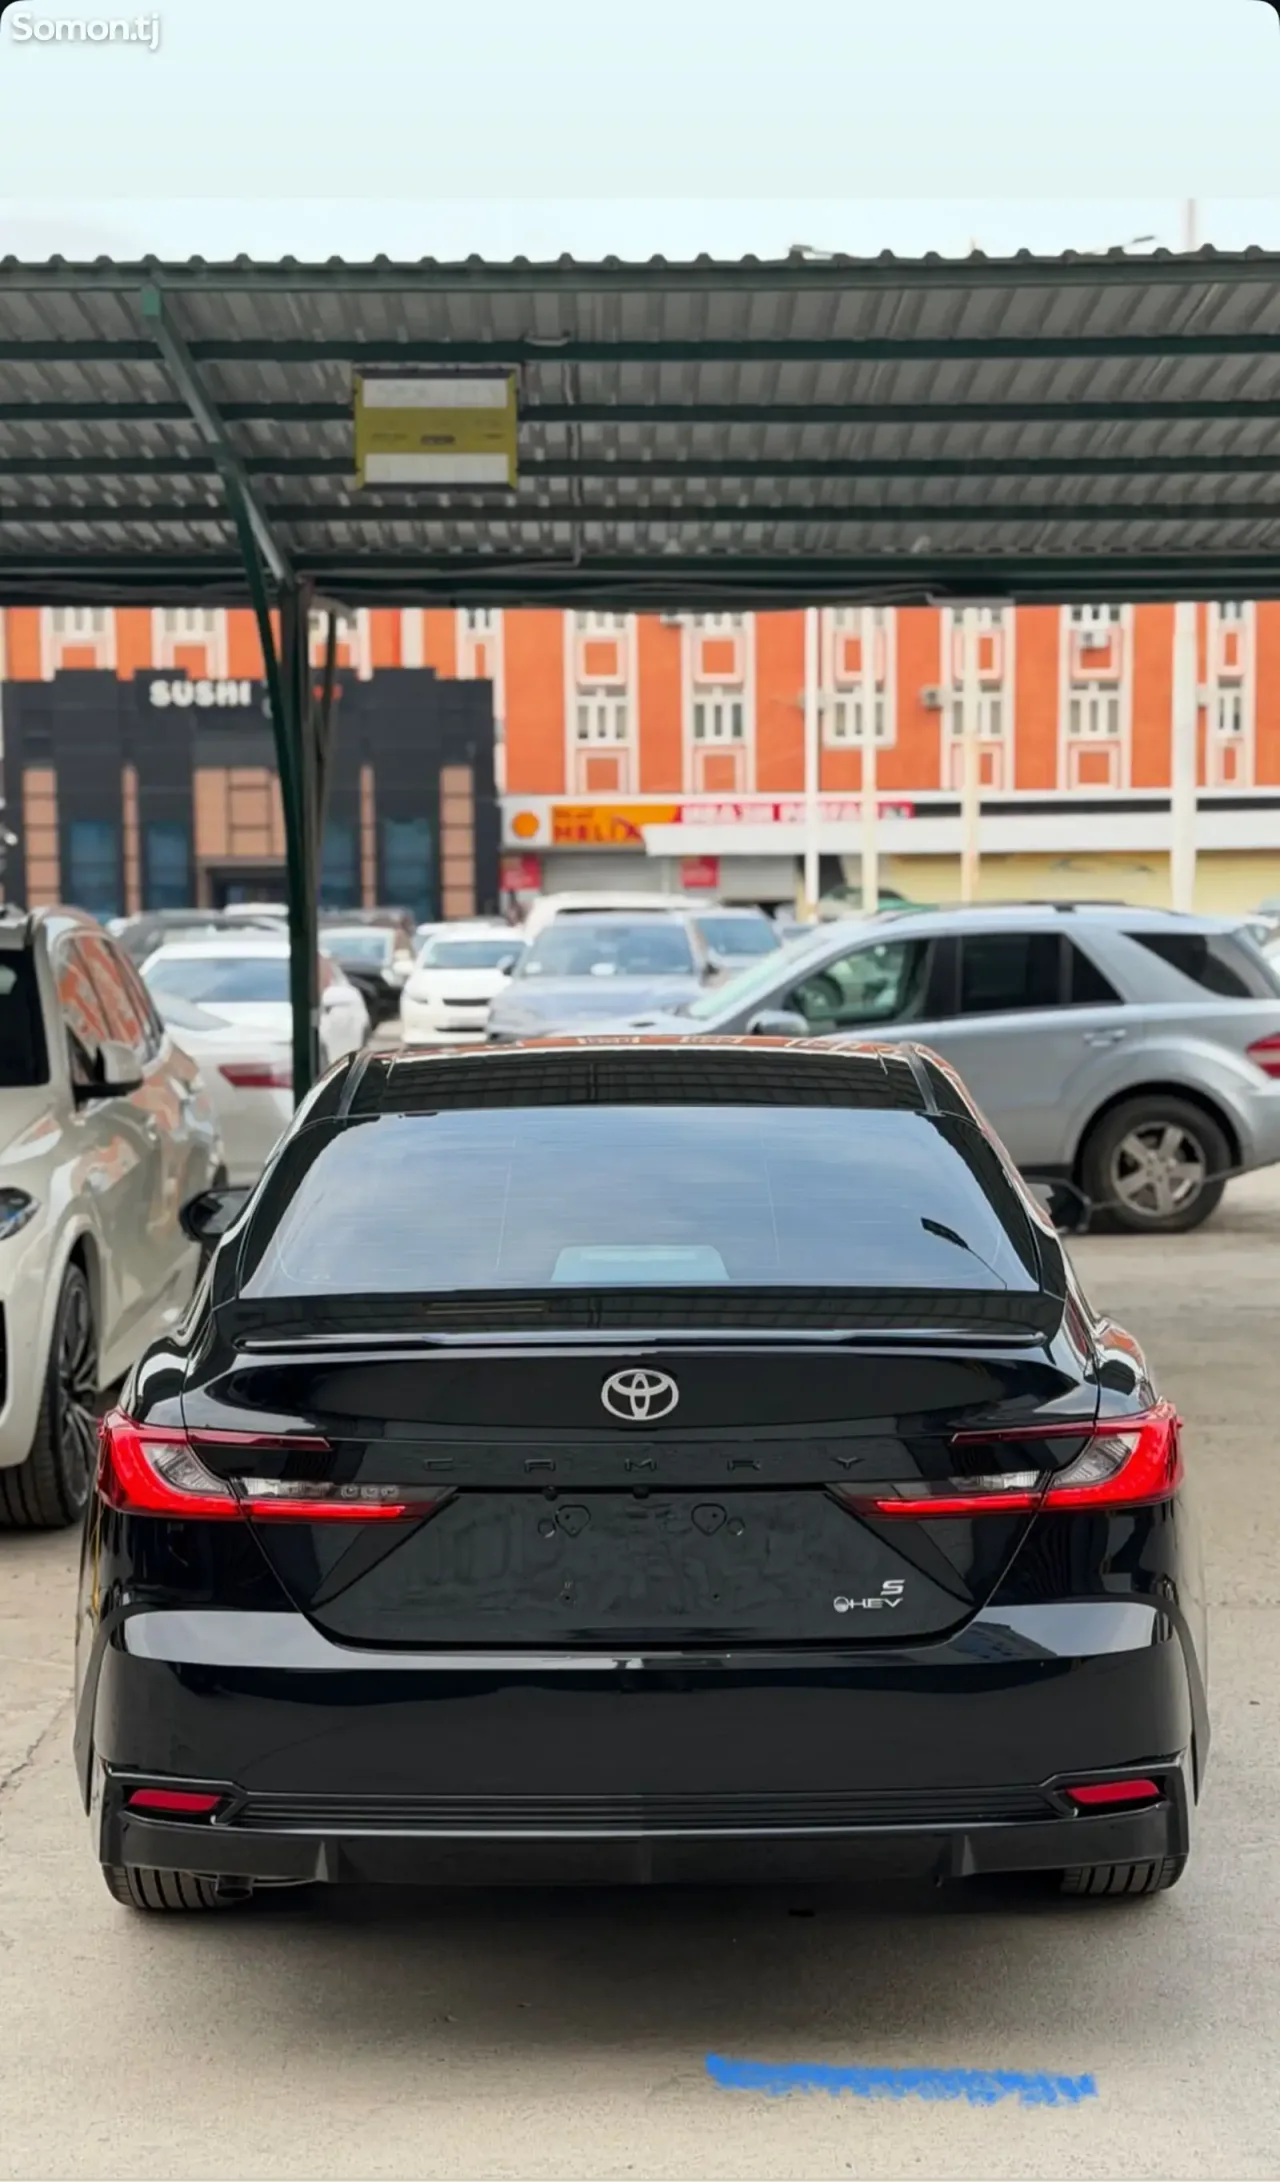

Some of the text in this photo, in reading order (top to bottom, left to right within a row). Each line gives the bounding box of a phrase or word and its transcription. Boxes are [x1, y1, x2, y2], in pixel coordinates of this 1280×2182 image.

[150, 679, 251, 708] SUSHI
[423, 1457, 864, 1474] CAMRY
[880, 1579, 906, 1596] S
[849, 1597, 904, 1610] HEV
